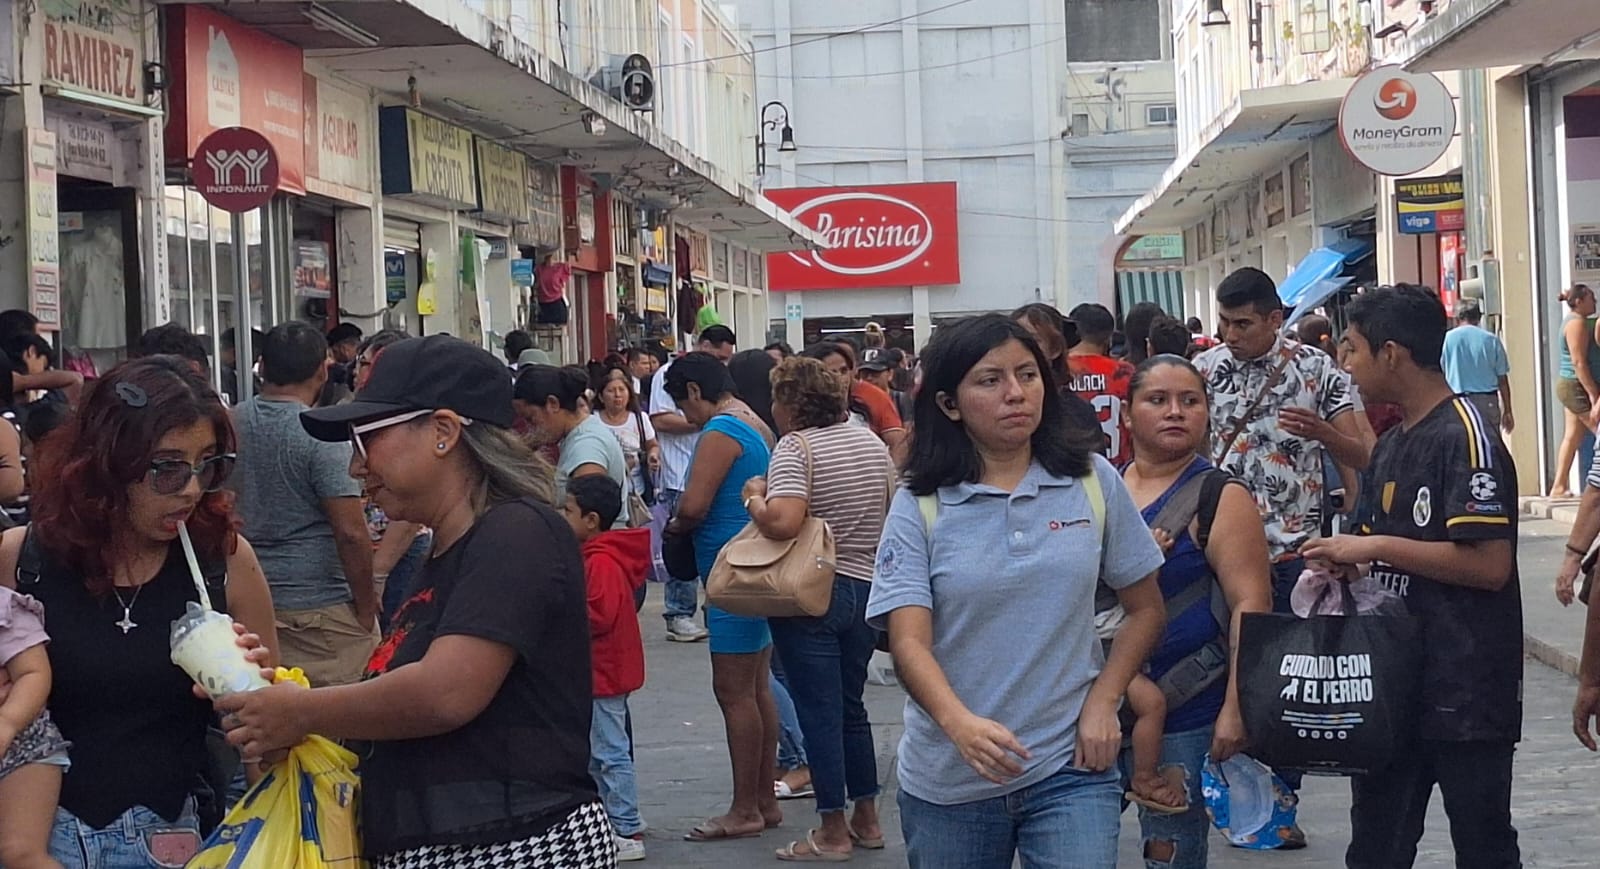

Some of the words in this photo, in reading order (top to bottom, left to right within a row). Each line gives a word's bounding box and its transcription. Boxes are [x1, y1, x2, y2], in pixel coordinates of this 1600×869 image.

[45, 23, 136, 99] RAMIREZ
[1353, 125, 1442, 141] MoneyGram
[206, 184, 269, 193] INFONAVIT
[816, 213, 920, 249] Parisina
[1406, 216, 1430, 227] vigo
[1280, 654, 1335, 679] CUIDADO
[1336, 654, 1371, 678] CON
[1303, 680, 1320, 704] EL
[1323, 678, 1373, 704] PERRO
